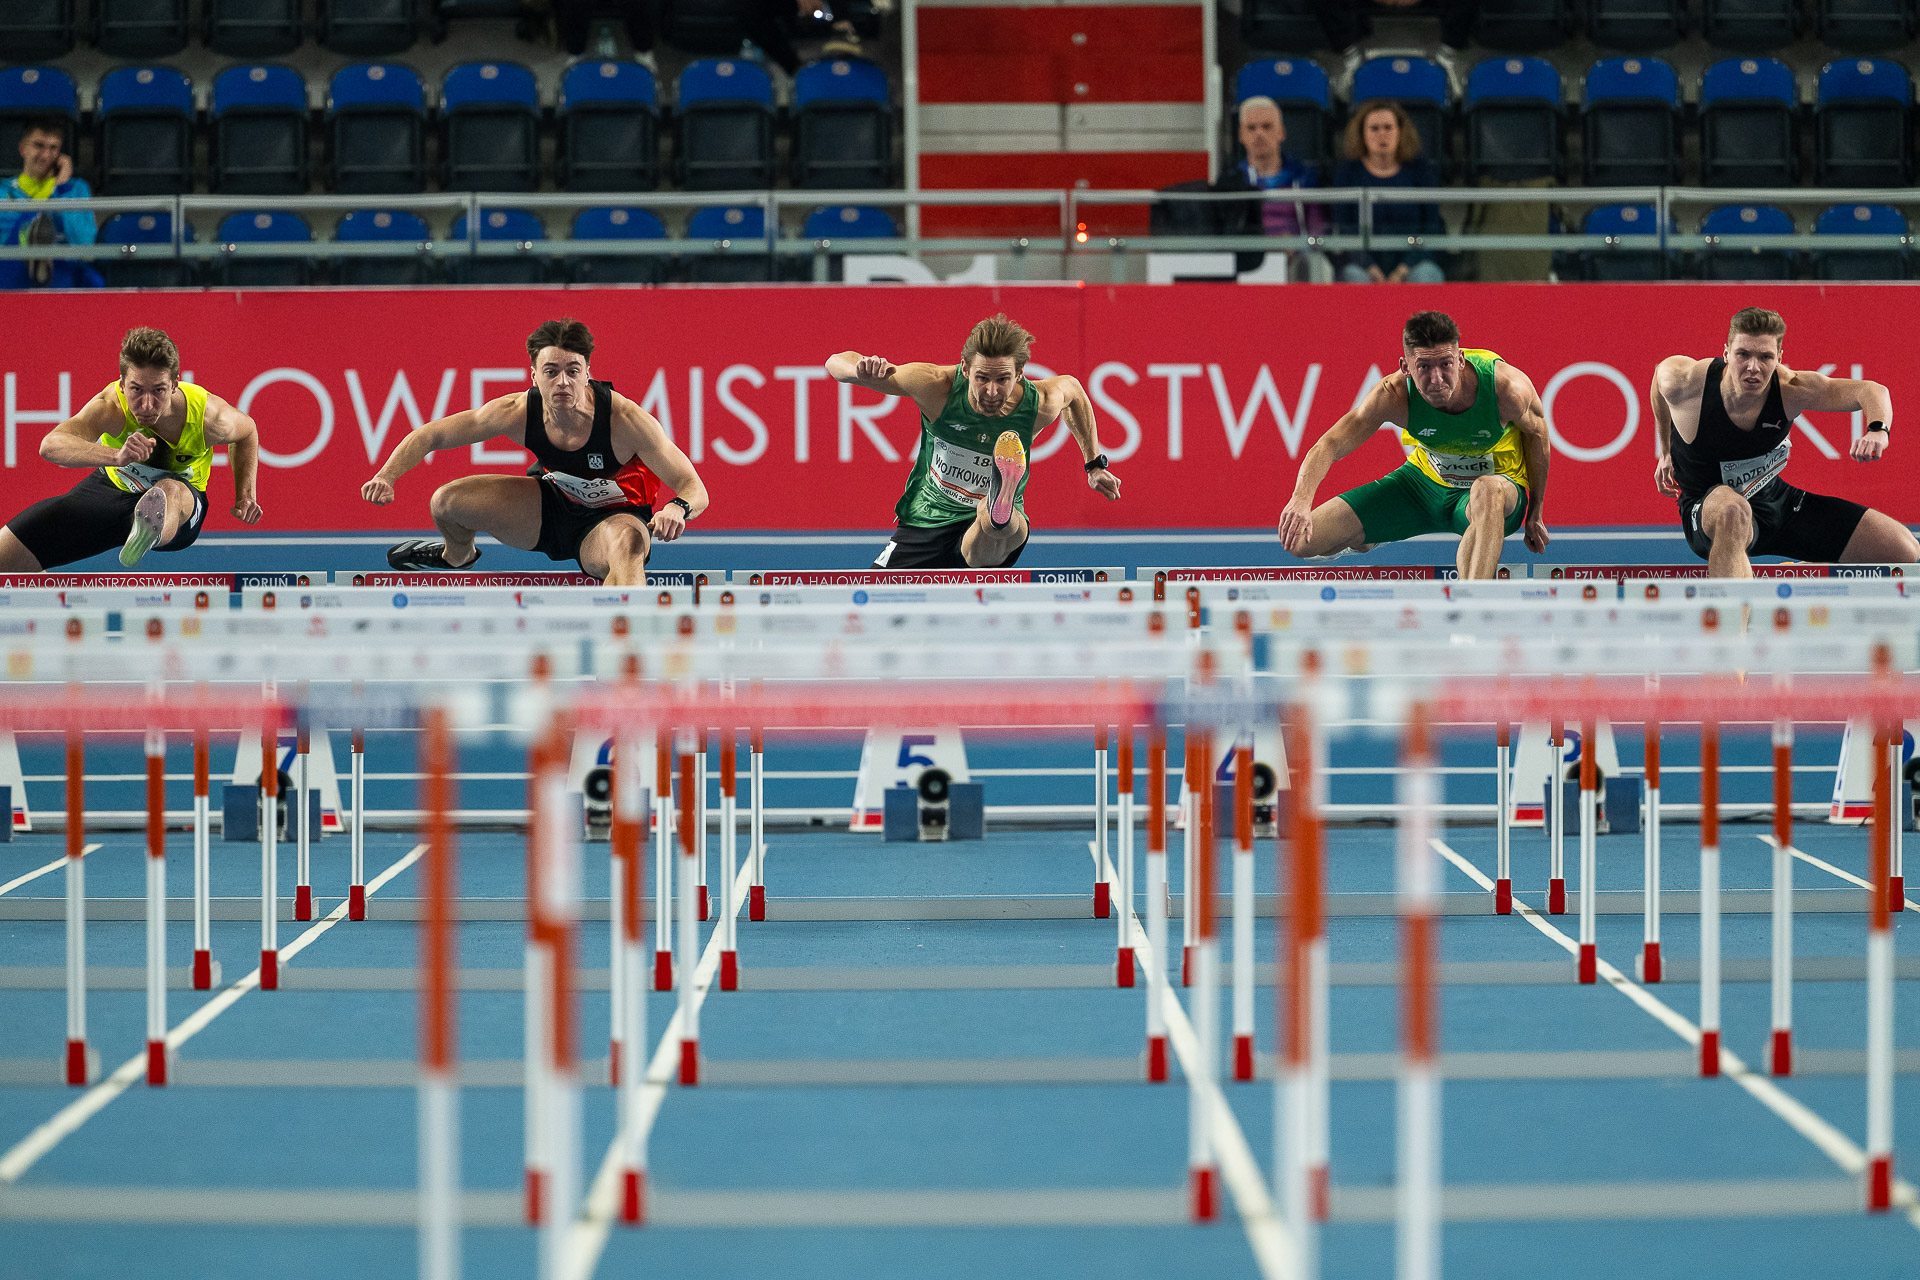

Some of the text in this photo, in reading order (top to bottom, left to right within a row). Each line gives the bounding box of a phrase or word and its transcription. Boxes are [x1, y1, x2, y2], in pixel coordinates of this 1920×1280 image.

[4, 367, 527, 468] HOWE
[640, 361, 1414, 468] ISTRSTW
[1417, 428, 1437, 437] 4F
[973, 455, 993, 468] 18
[935, 453, 992, 489] WOJTKOWSK
[1727, 449, 1786, 488] RADZEWICZ
[581, 480, 609, 489] 258
[1038, 571, 1086, 584] TORUŃ
[1176, 570, 1426, 582] PZLA HALOWE MISTRZOSTWA POLSKI
[1574, 569, 1822, 580] PZLA HALOWE MISTWA POLSKI
[1836, 566, 1883, 579] TORUŃ
[18, 577, 78, 588] HALOWE
[82, 577, 175, 588] MISTRZOSTWA
[180, 576, 227, 588] POLSKI
[242, 574, 289, 588] TORUŃ
[373, 577, 405, 587] PZLA
[410, 577, 471, 587] HALOWE
[475, 577, 570, 587] MISTRZOSTWA
[646, 573, 685, 586] ORUŃ
[772, 574, 1023, 586] PZLA HALOWE MISTRZOSTWA POLSKI
[896, 734, 937, 788] 5
